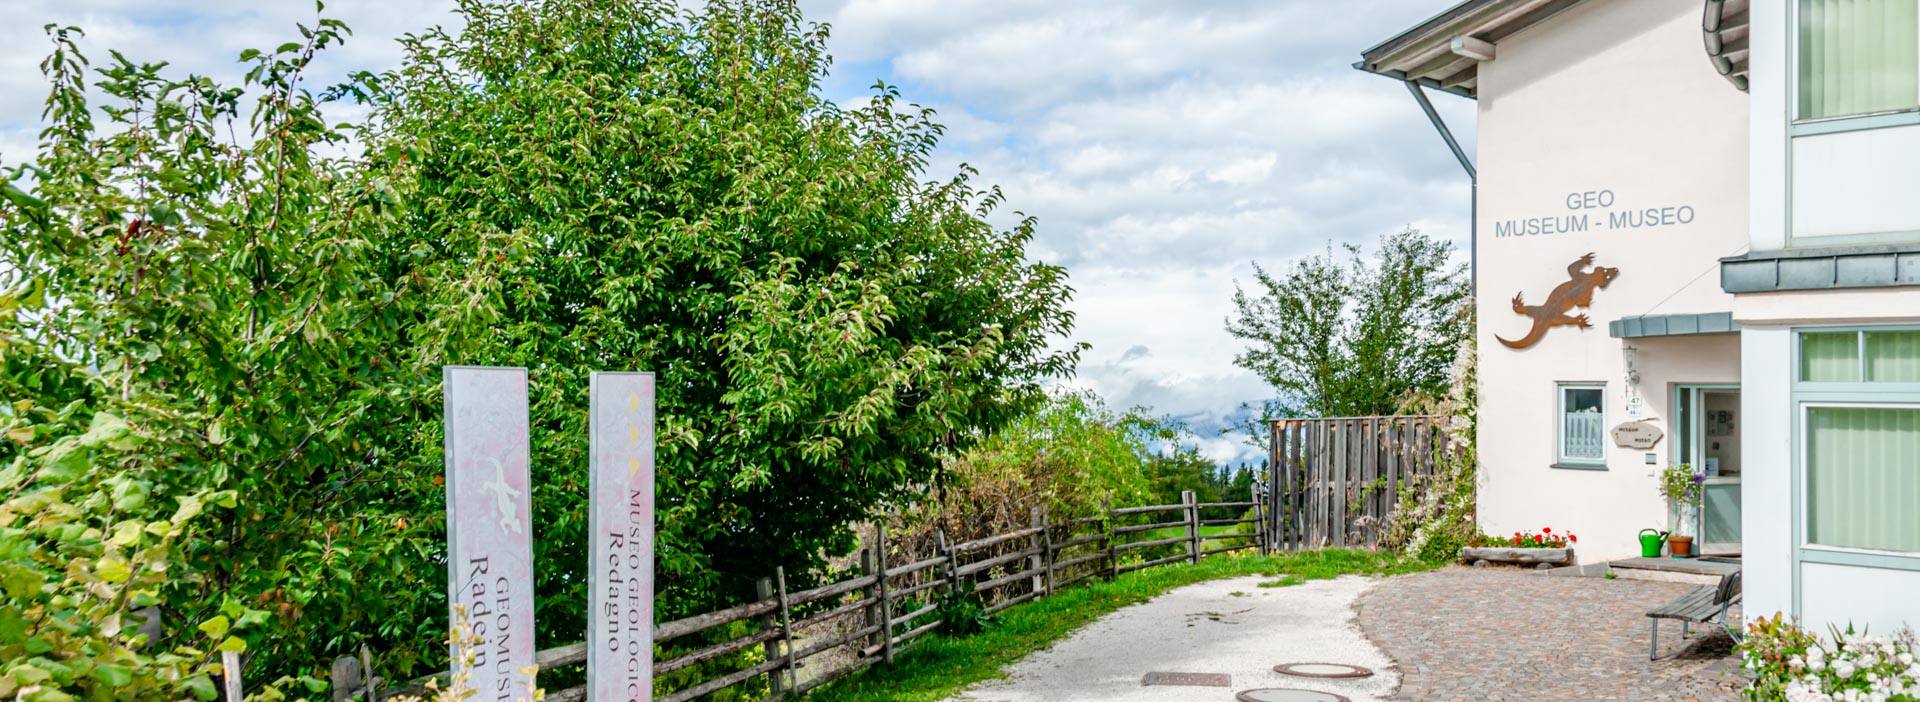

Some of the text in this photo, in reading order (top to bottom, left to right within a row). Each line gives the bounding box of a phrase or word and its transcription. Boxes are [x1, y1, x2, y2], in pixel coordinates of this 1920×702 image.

[1495, 215, 1588, 238] MUSEUM
[1609, 206, 1694, 229] MUSEO
[1566, 190, 1614, 210] GEO
[470, 556, 492, 669] Radein
[604, 532, 624, 652] Redagno
[627, 489, 641, 702] MUSEO GEOLOGIC
